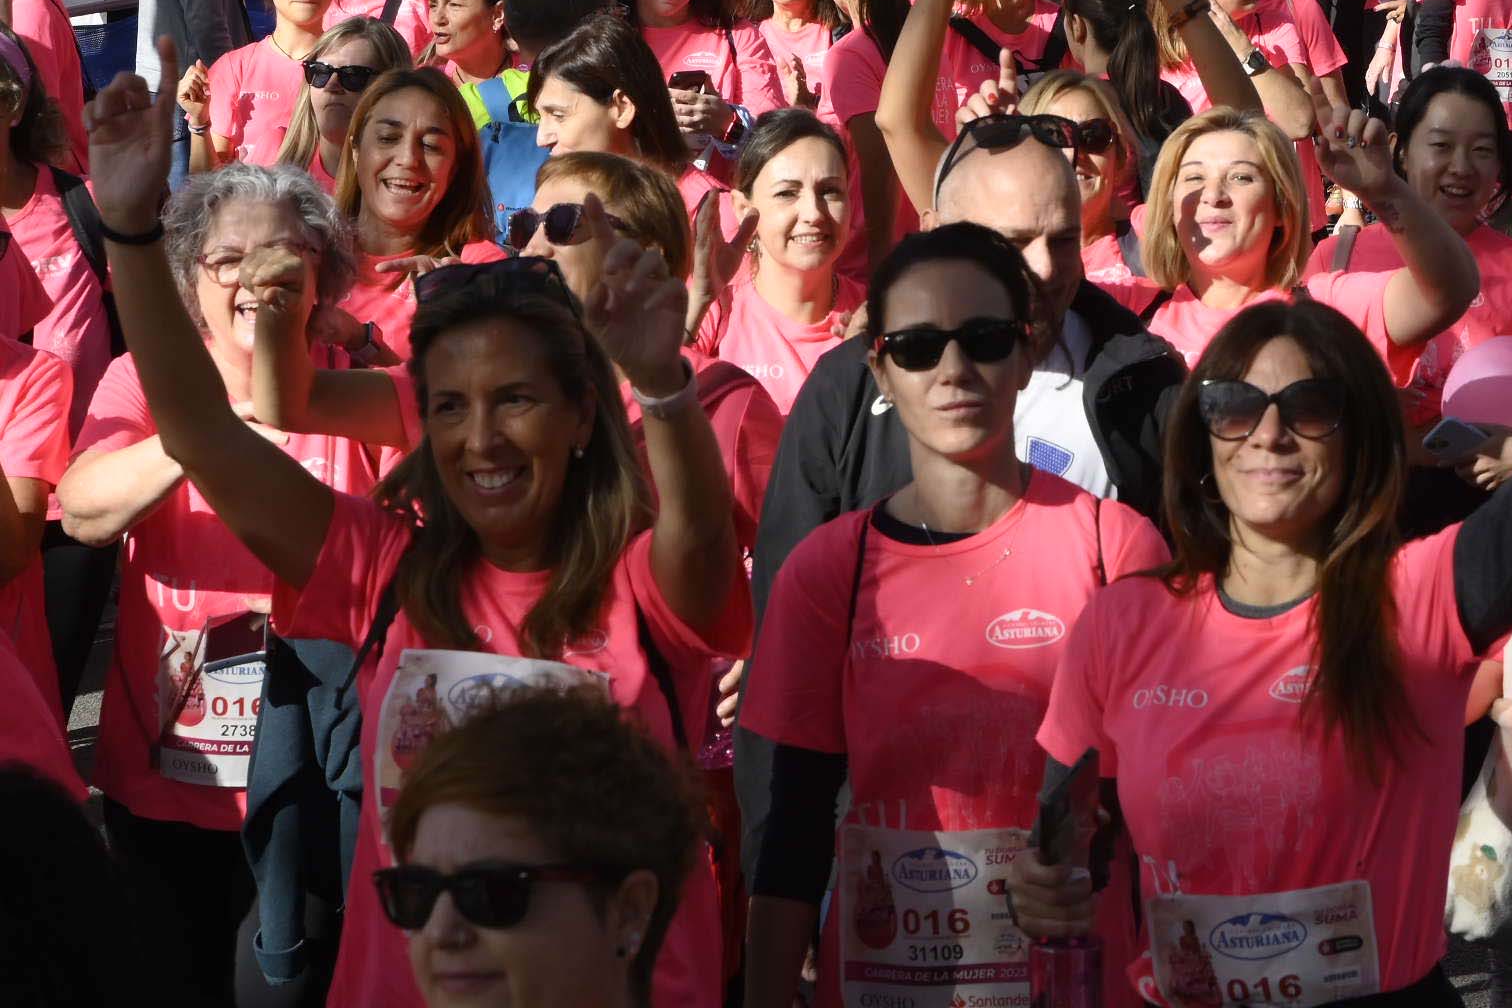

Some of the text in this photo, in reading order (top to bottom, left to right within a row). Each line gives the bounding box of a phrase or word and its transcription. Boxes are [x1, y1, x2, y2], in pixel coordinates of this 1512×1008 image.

[992, 623, 1059, 640] ASTURIANA
[220, 744, 234, 752] DE
[236, 744, 249, 753] LA
[899, 862, 971, 882] ASTURIANA
[902, 908, 971, 936] 016
[1217, 927, 1299, 950] ASTURIANA
[908, 944, 964, 962] 31109
[953, 966, 996, 980] MUJER
[1226, 974, 1302, 1004] 016
